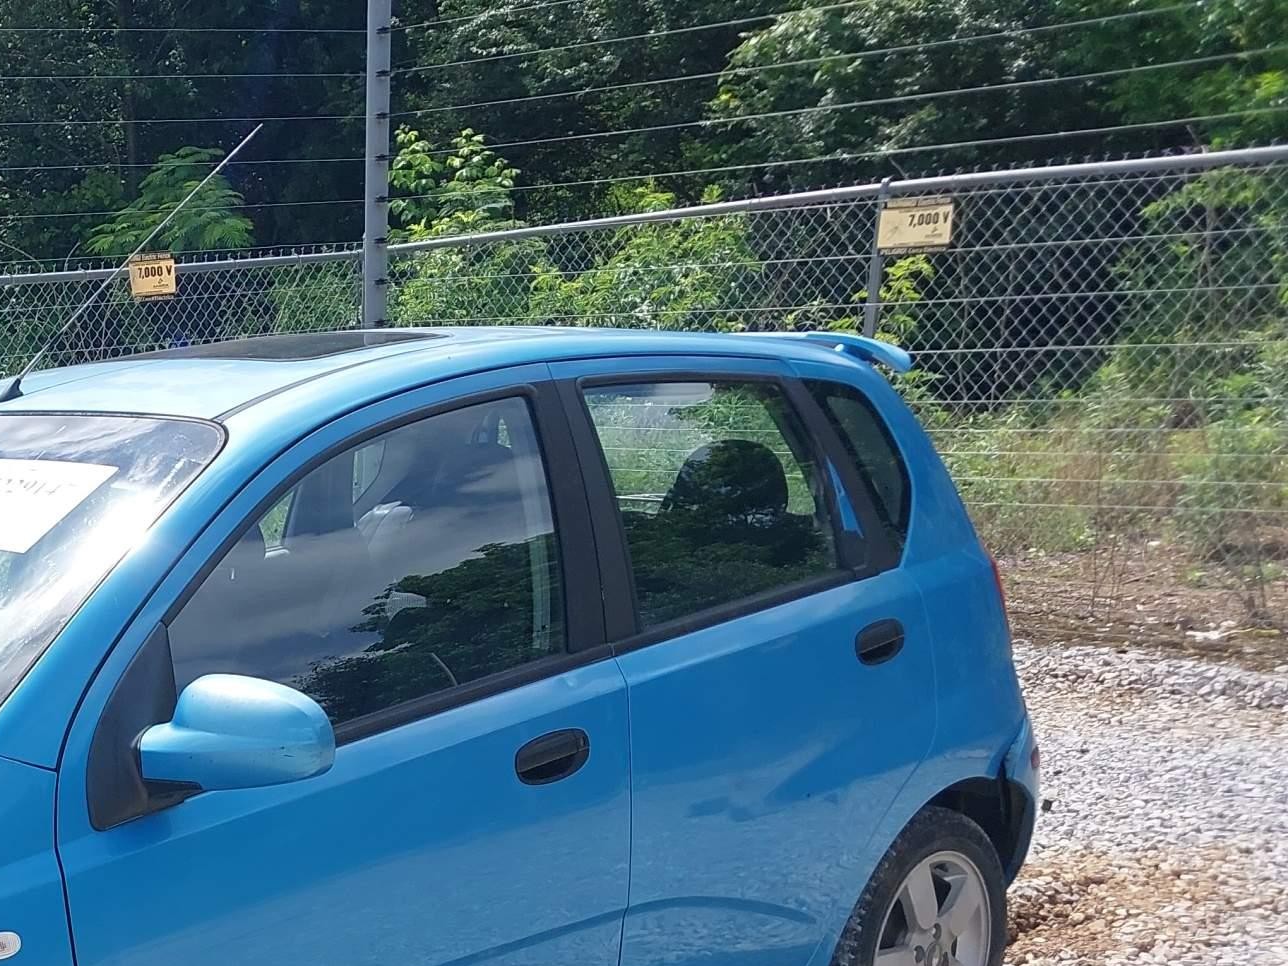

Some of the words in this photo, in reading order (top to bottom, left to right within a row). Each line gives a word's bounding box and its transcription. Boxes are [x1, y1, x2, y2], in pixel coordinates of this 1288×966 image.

[908, 212, 939, 228] 7,000
[942, 210, 950, 224] V
[138, 266, 163, 279] 7,000
[166, 265, 172, 276] V
